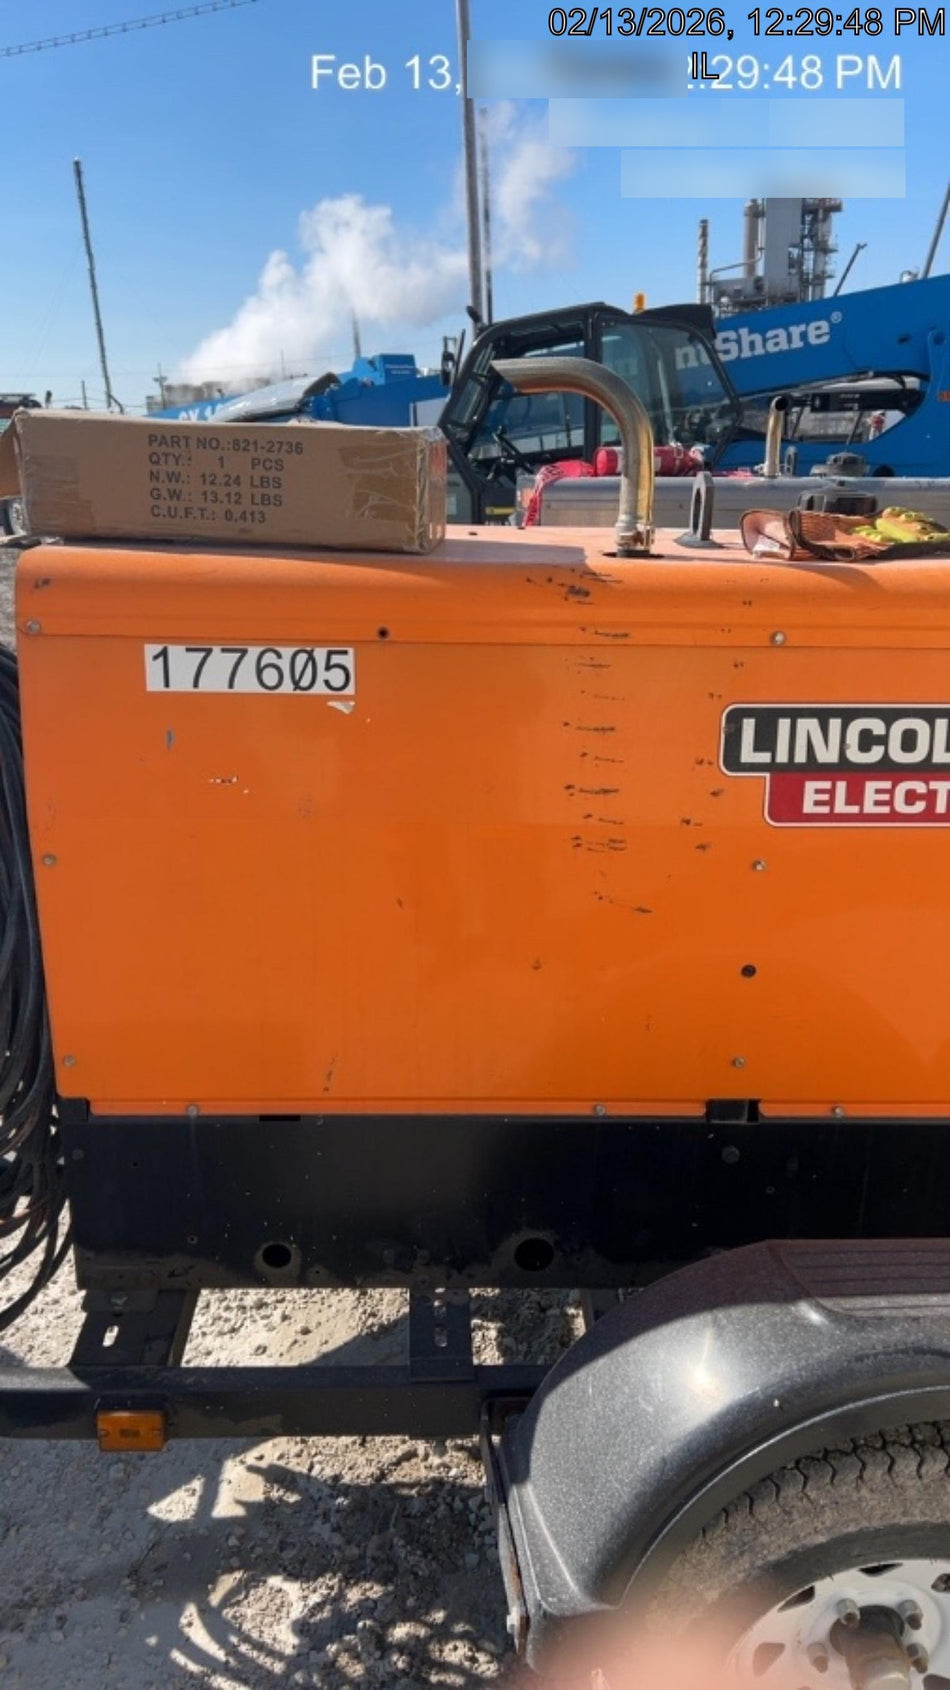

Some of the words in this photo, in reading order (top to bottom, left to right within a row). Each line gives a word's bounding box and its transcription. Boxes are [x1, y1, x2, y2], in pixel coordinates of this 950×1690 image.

[148, 433, 191, 449] PART
[217, 455, 225, 469] 1
[251, 457, 284, 471] PCS
[201, 472, 241, 487] 12.24
[250, 475, 282, 489] LBS
[202, 490, 242, 505] 13.12
[250, 493, 283, 507] LBS
[224, 508, 266, 524] 0.413
[152, 646, 351, 691] 177605
[803, 780, 950, 814] ELECT
